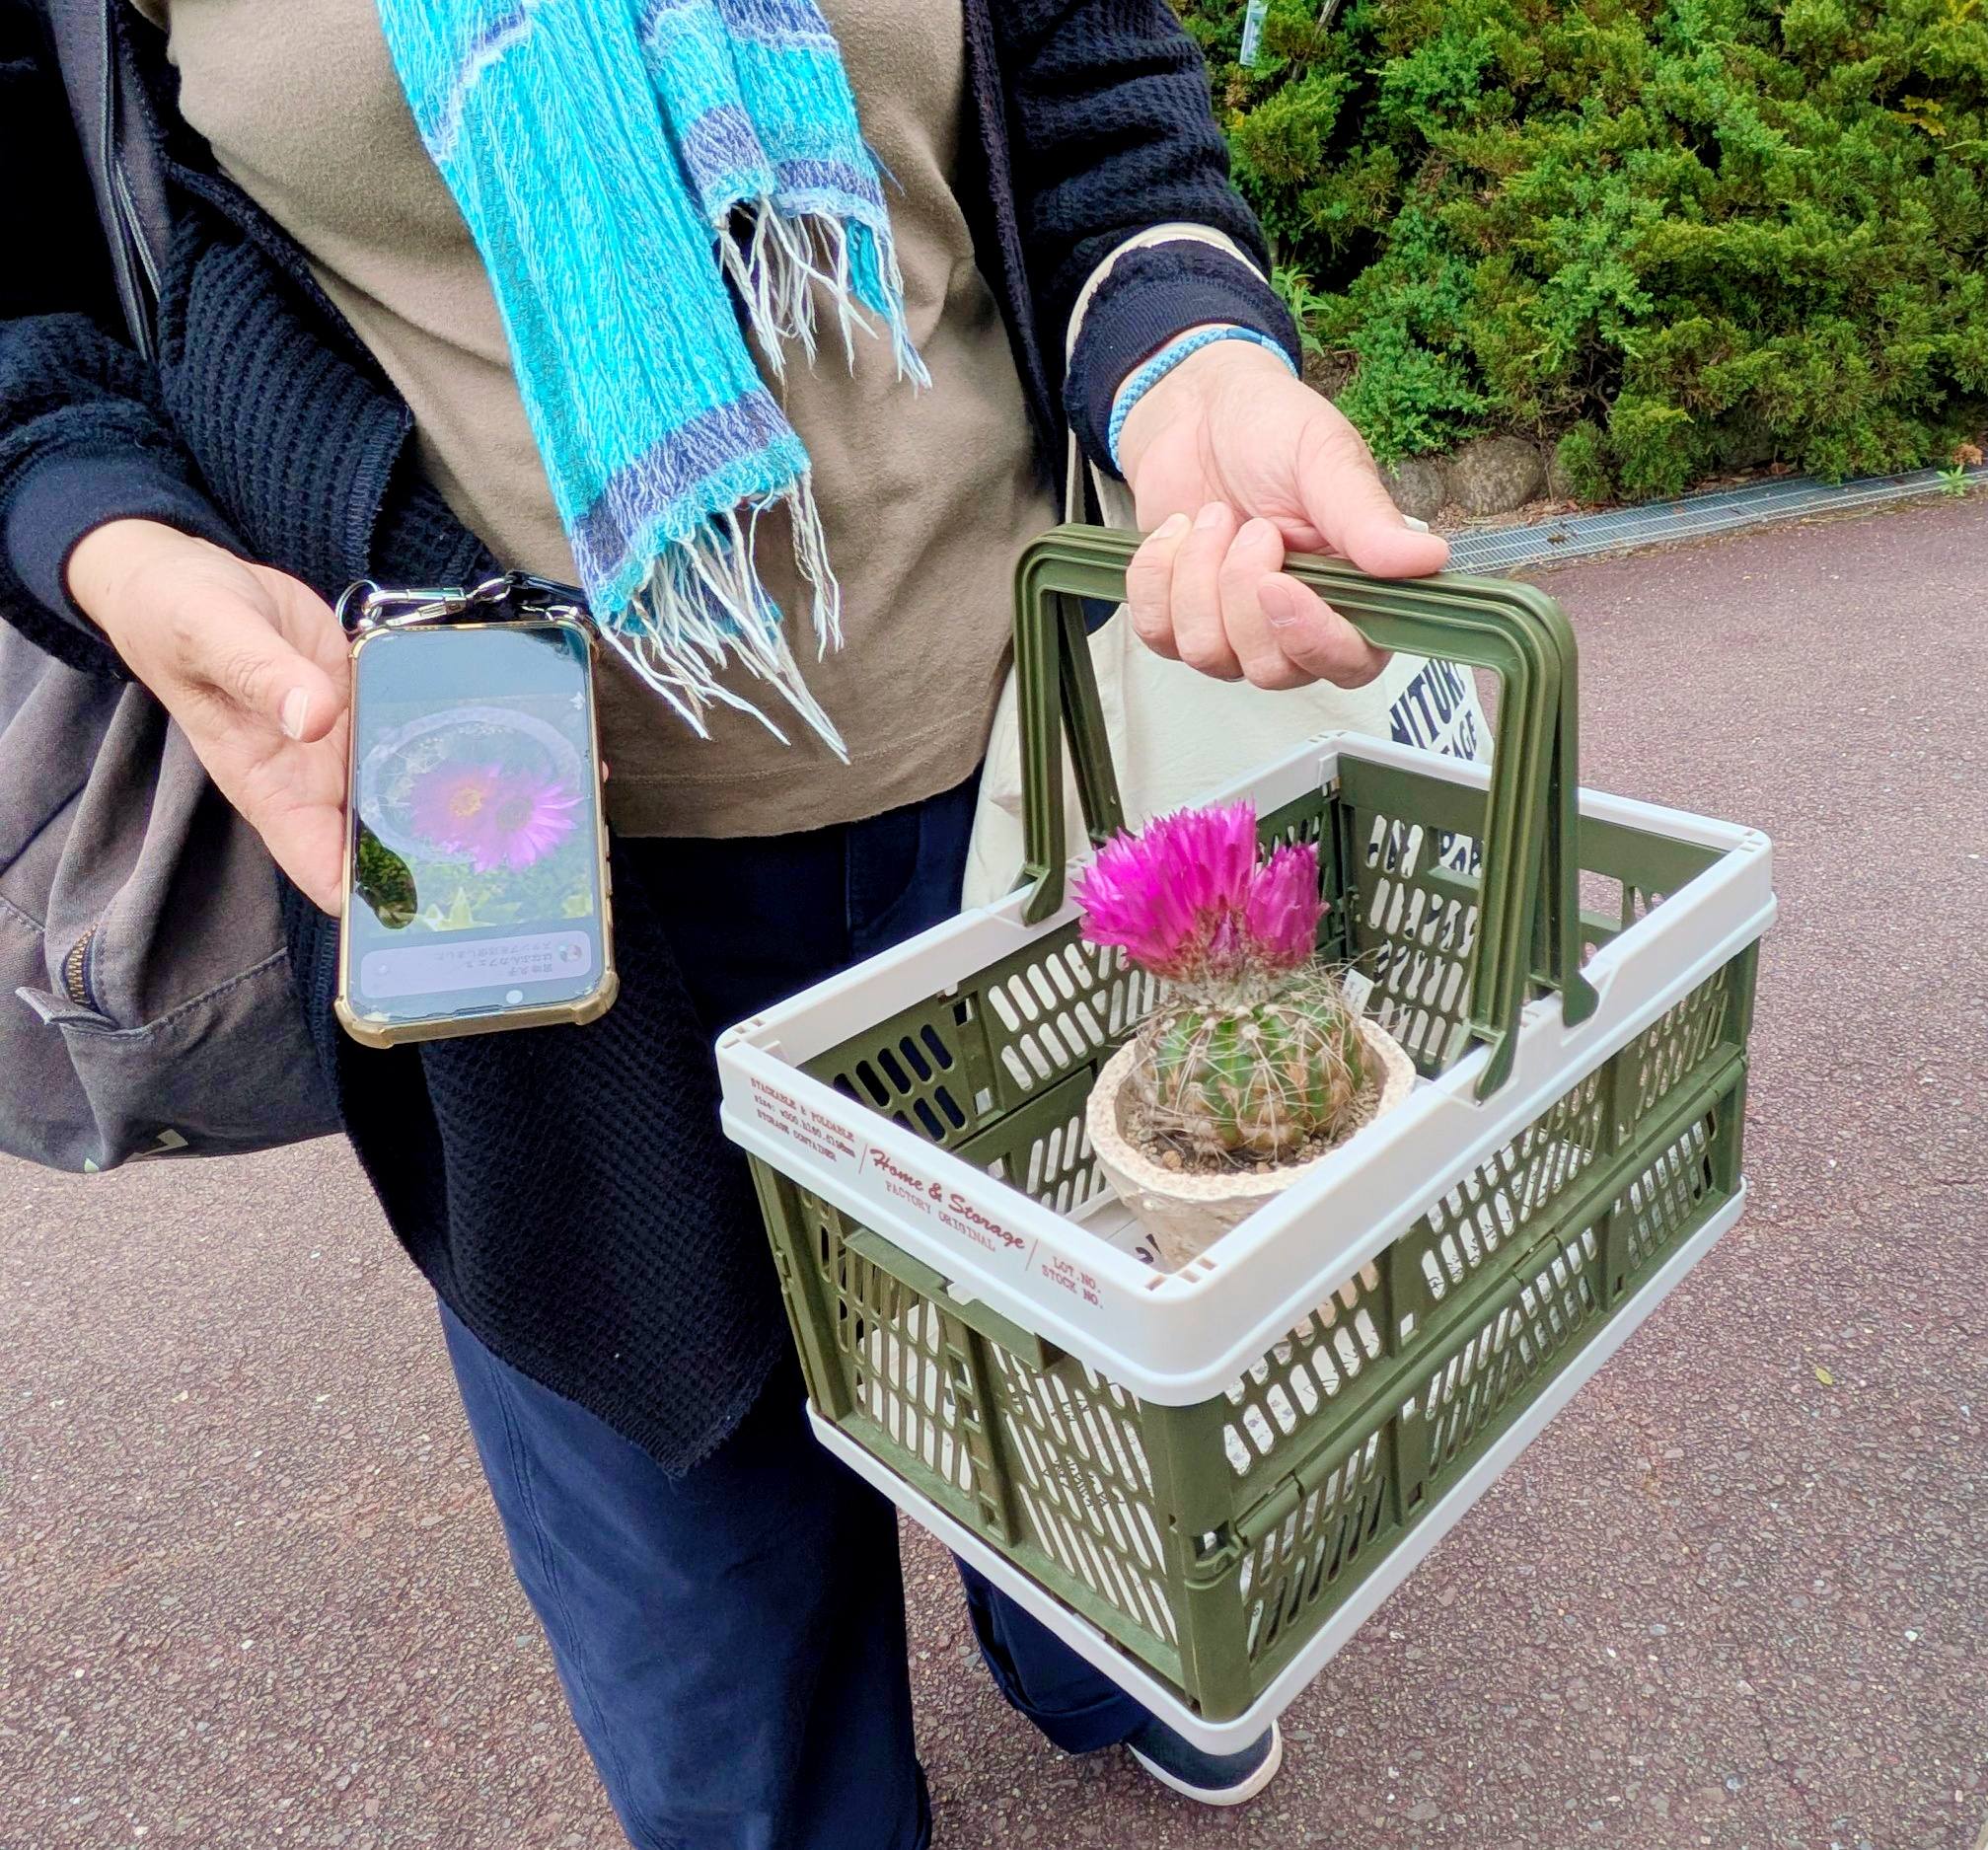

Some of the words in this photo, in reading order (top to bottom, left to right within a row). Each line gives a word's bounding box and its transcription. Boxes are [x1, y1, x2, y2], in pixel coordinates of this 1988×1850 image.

[869, 1148, 923, 1191] Home
[928, 1182, 942, 1203] &
[948, 1193, 1025, 1249] Storage
[885, 1179, 931, 1215] FACTORY
[938, 1211, 995, 1252] ORIGINAL
[1042, 1264, 1077, 1295] STOCK
[1083, 1288, 1104, 1309] NO.
